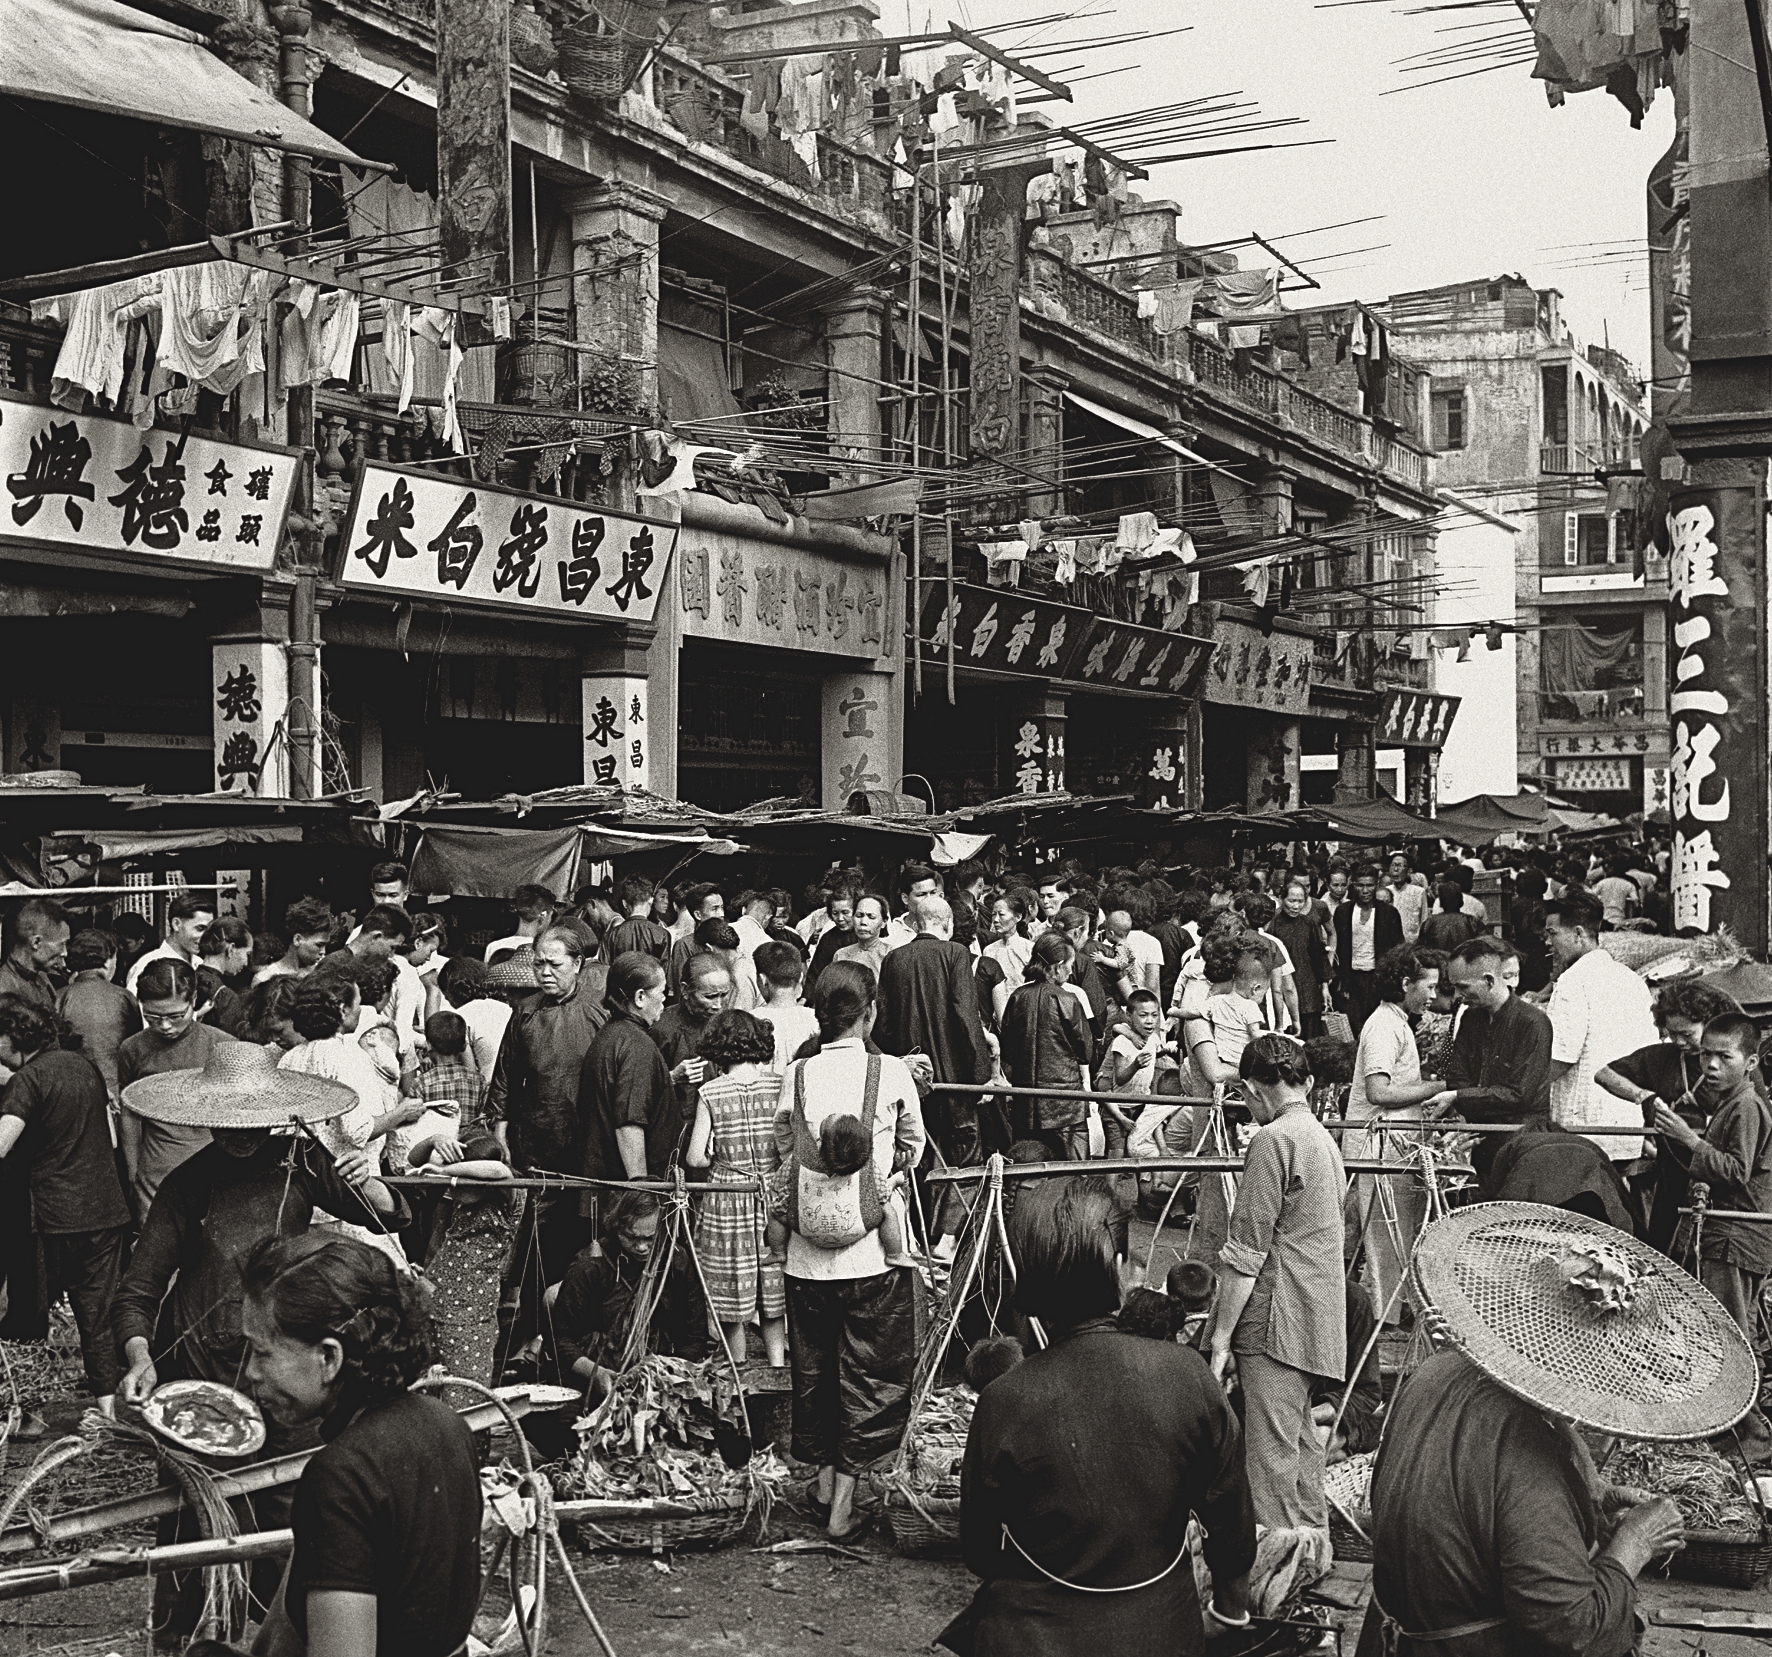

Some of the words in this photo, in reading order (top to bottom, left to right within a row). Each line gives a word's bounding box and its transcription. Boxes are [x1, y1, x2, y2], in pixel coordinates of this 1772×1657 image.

[354, 476, 653, 613] 東昌號白米
[217, 664, 262, 792] 德興
[585, 696, 624, 786] 東昌
[629, 694, 645, 790] 東昌
[1014, 721, 1044, 793] 泉香
